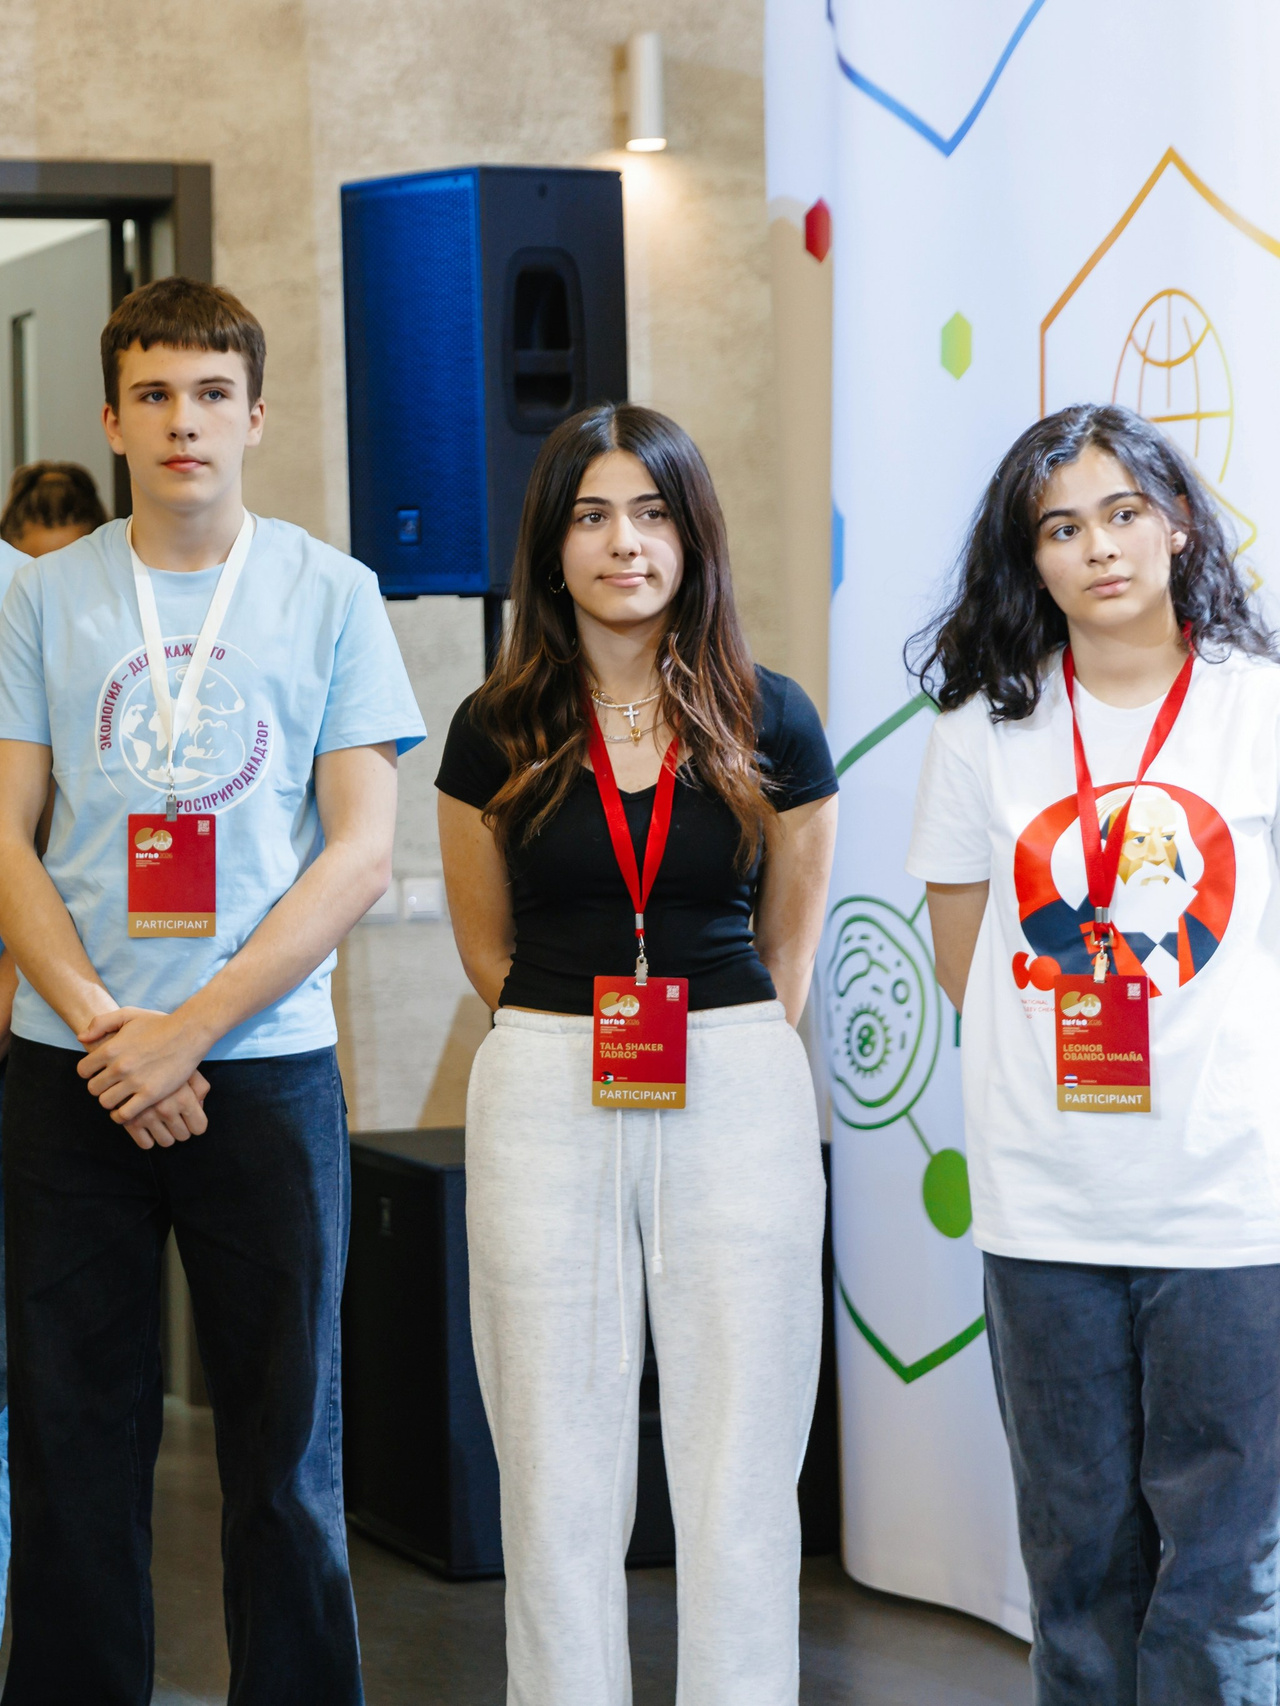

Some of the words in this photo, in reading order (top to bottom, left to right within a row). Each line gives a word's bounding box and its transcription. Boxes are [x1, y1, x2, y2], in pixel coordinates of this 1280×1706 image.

[99, 680, 123, 751] ЭКОЛОГИЯ
[164, 643, 226, 661] КАЖГО
[176, 720, 270, 813] РОСПРИРОДНАДЗОР
[136, 920, 209, 929] PARTICIPIANT
[600, 1042, 624, 1051] TALA
[625, 1042, 664, 1052] SHAKER
[1063, 1044, 1103, 1053] LEONOR
[600, 1050, 638, 1059] TADROS
[1063, 1052, 1105, 1061] OBANDO
[1106, 1051, 1144, 1062] UMAÑA
[600, 1089, 677, 1101] PARTICIPIANT
[1064, 1093, 1143, 1105] PARTICIPIANT
